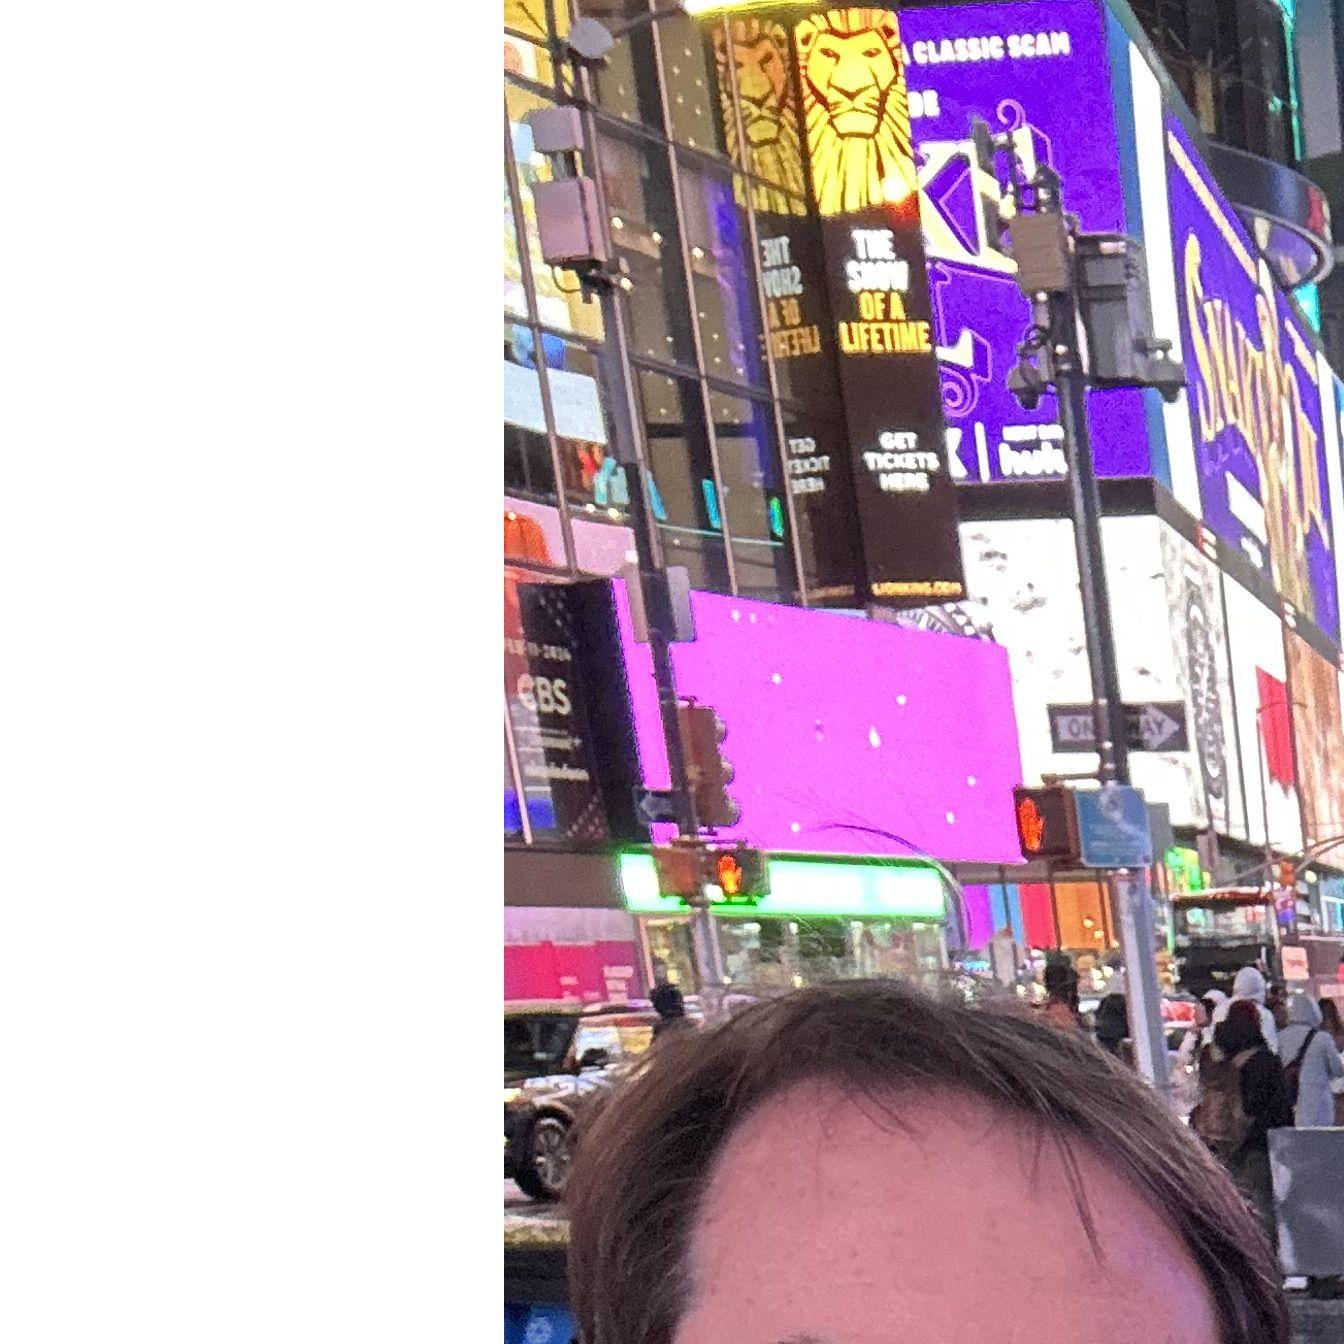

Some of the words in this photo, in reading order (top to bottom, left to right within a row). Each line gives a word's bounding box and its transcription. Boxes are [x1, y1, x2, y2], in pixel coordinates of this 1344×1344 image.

[912, 35, 1005, 65] CLASSIC
[1006, 31, 1071, 59] SCAM
[851, 229, 897, 259] THE
[845, 259, 909, 293] SHOW
[859, 291, 886, 321] OF
[889, 291, 907, 321] A
[838, 320, 932, 354] LIFETIME
[879, 431, 918, 451] GET
[862, 451, 941, 472] TICKETS
